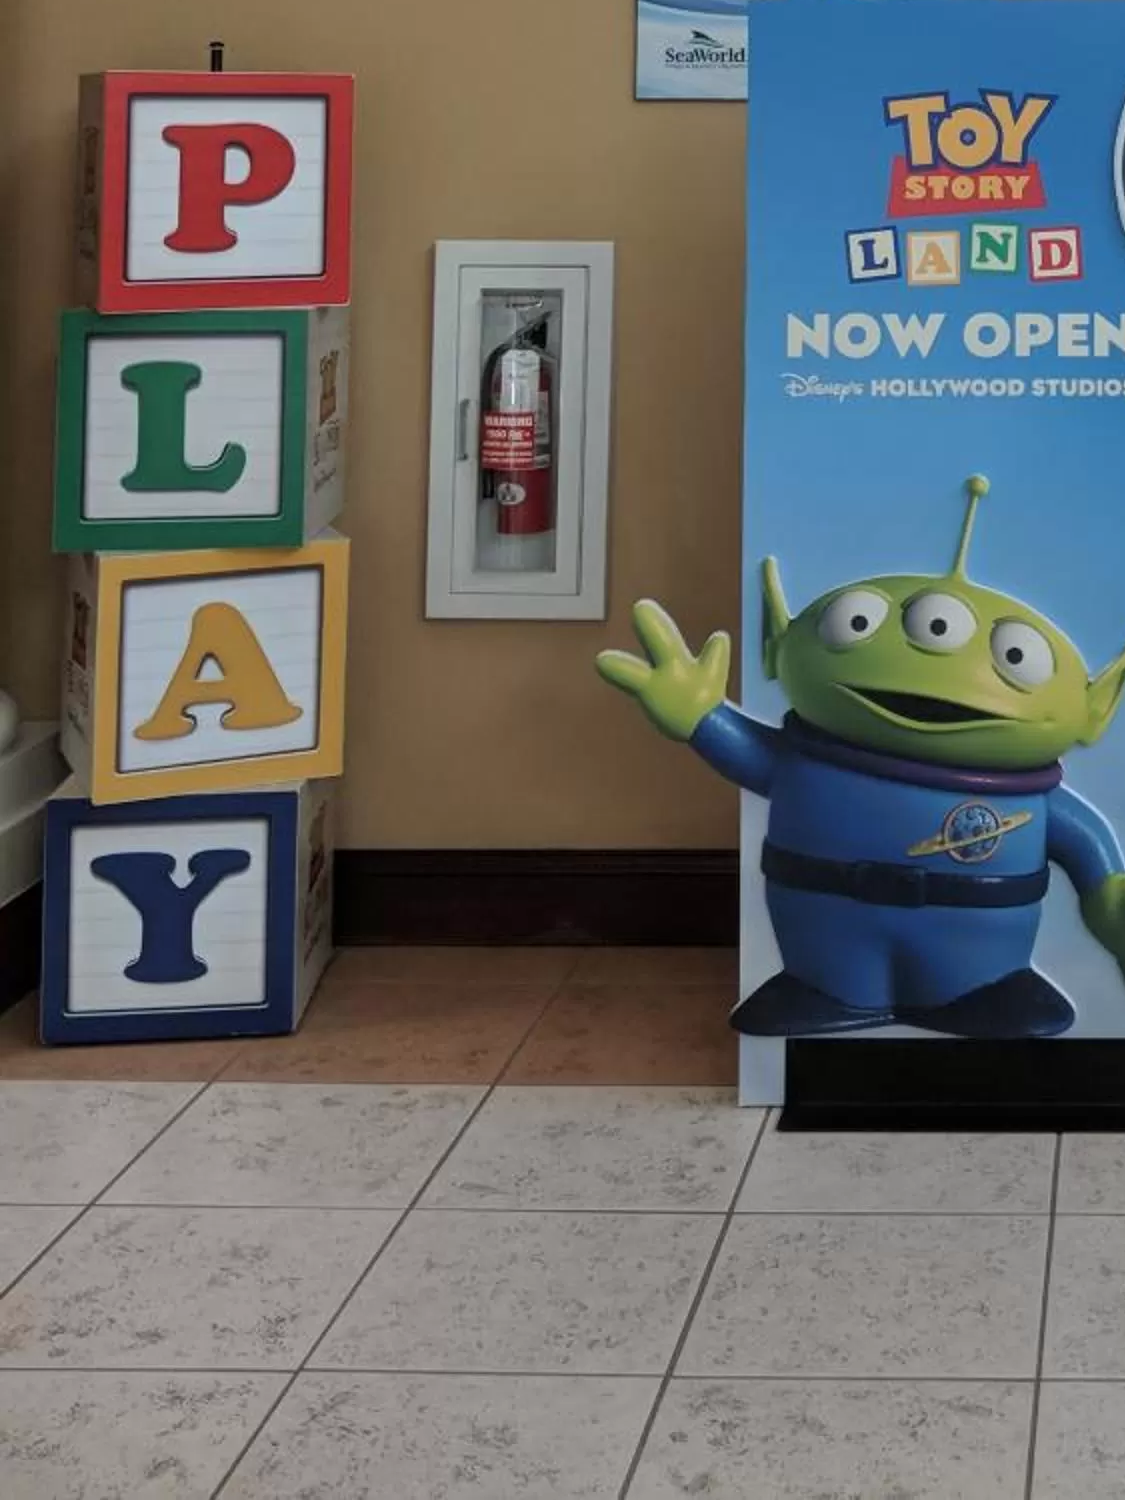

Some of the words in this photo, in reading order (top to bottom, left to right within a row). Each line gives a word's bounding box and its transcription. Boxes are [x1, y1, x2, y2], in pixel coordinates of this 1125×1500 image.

[665, 47, 745, 62] SeaWorld
[884, 90, 1057, 170] TOY
[904, 174, 1031, 201] STORY
[854, 229, 1076, 275] LAND
[786, 312, 946, 358] NOW
[780, 373, 865, 403] Disney's
[871, 378, 1025, 398] HOLLYWOOD
